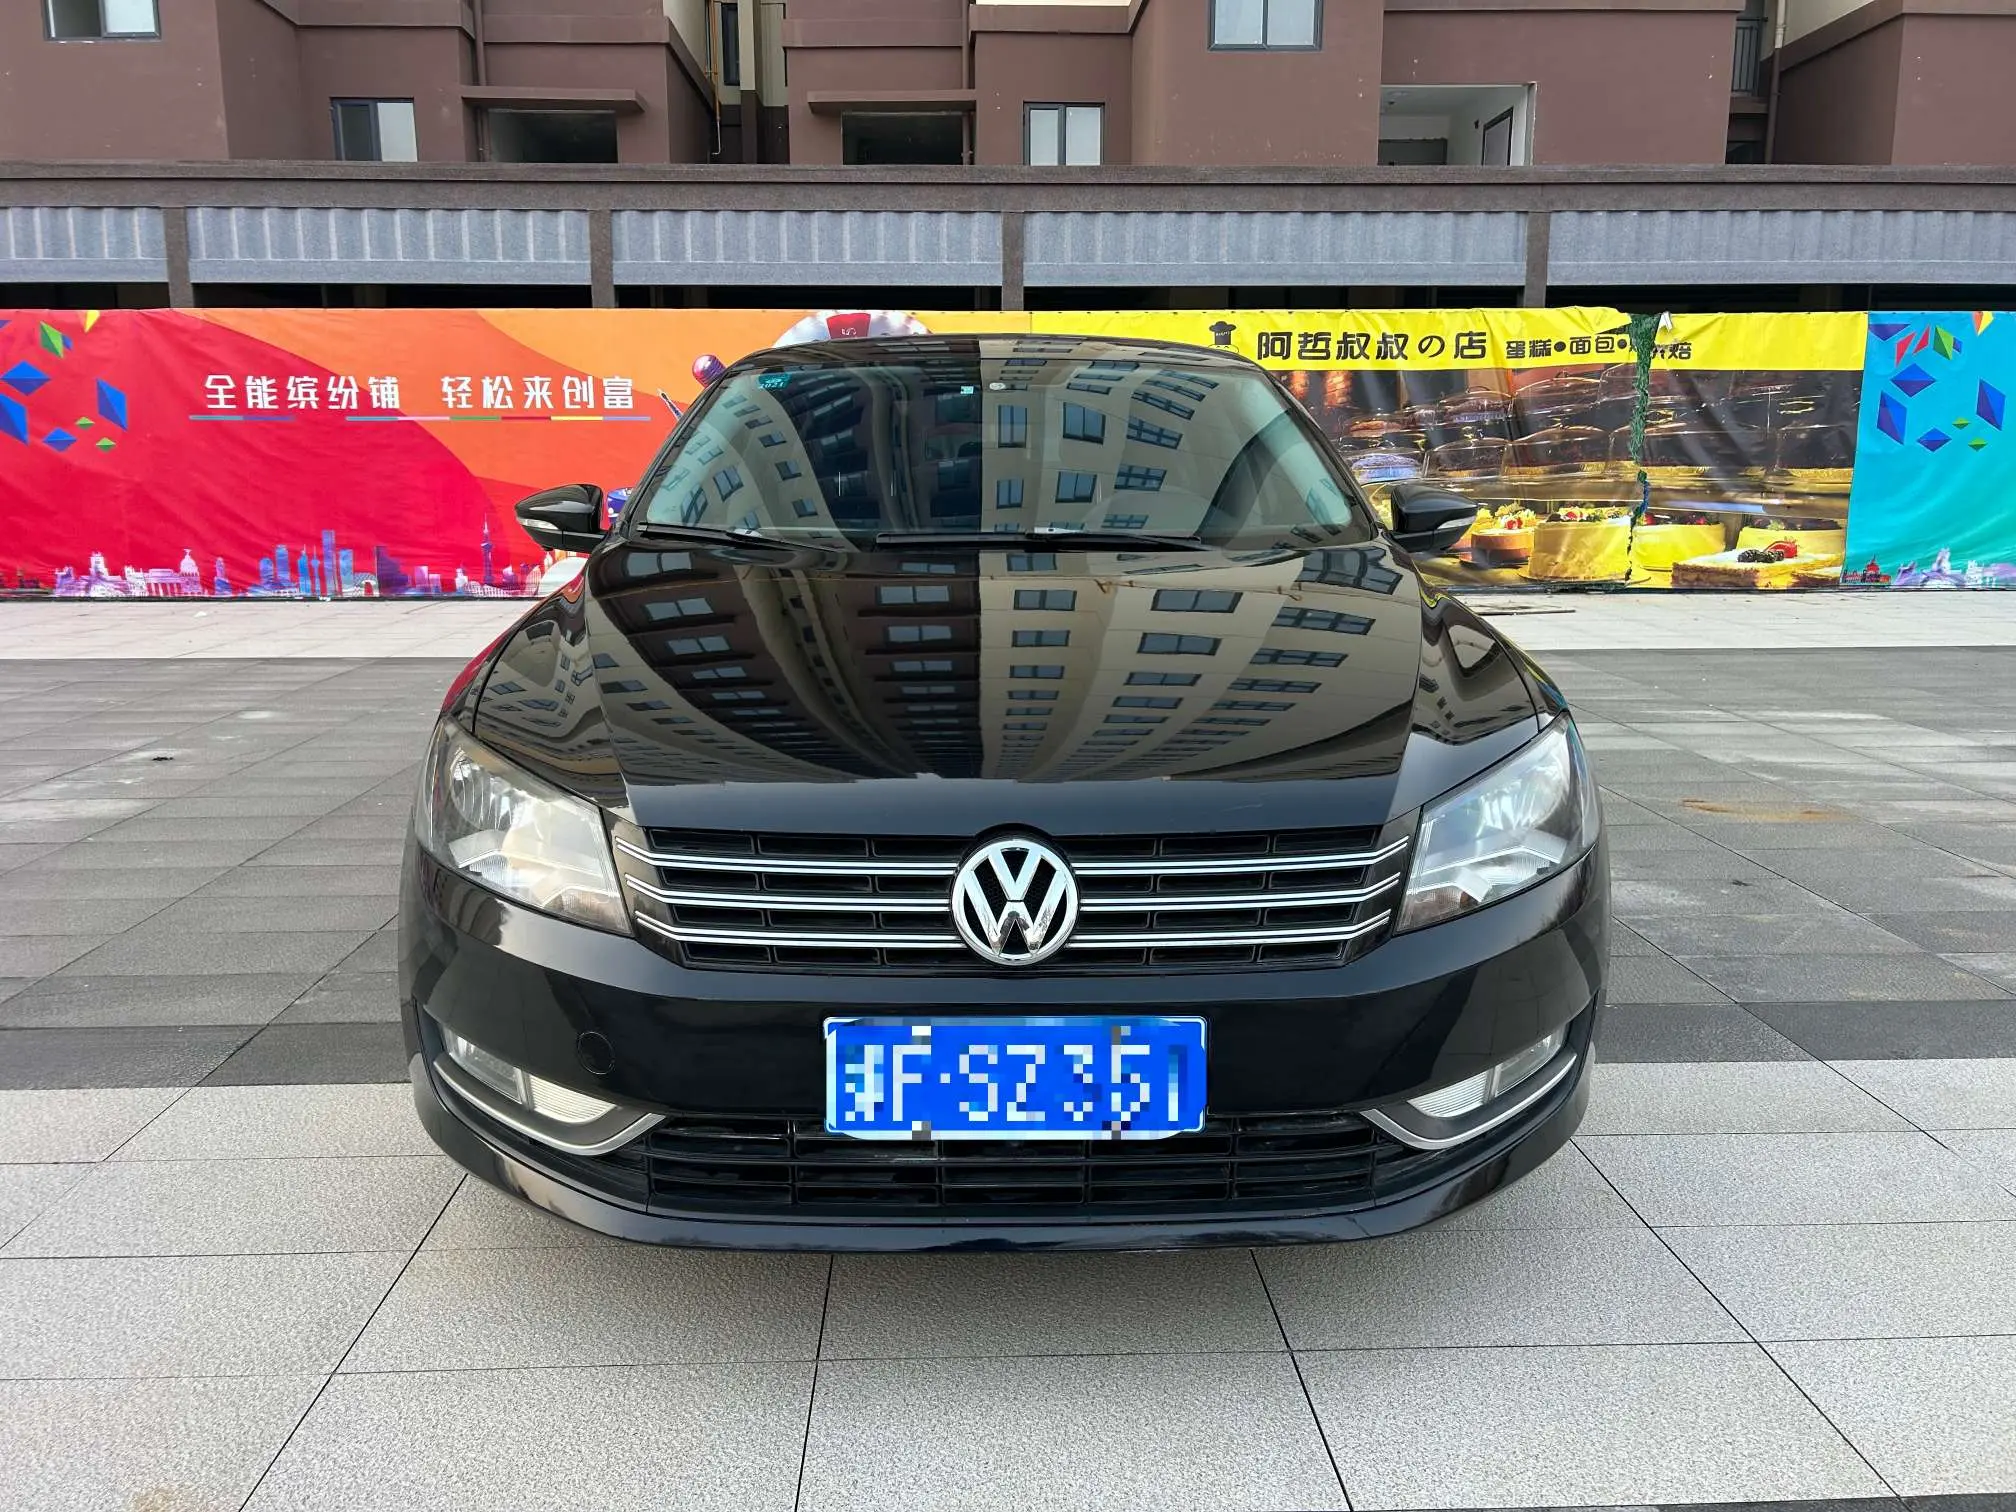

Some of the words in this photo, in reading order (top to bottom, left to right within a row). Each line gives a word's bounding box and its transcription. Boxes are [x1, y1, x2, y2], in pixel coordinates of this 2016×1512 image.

[1257, 331, 1487, 360] 阿哲叔叔の店
[204, 374, 401, 409] 全能缤纷铺
[440, 375, 634, 409] 轻松来创富
[952, 840, 1078, 965] VW
